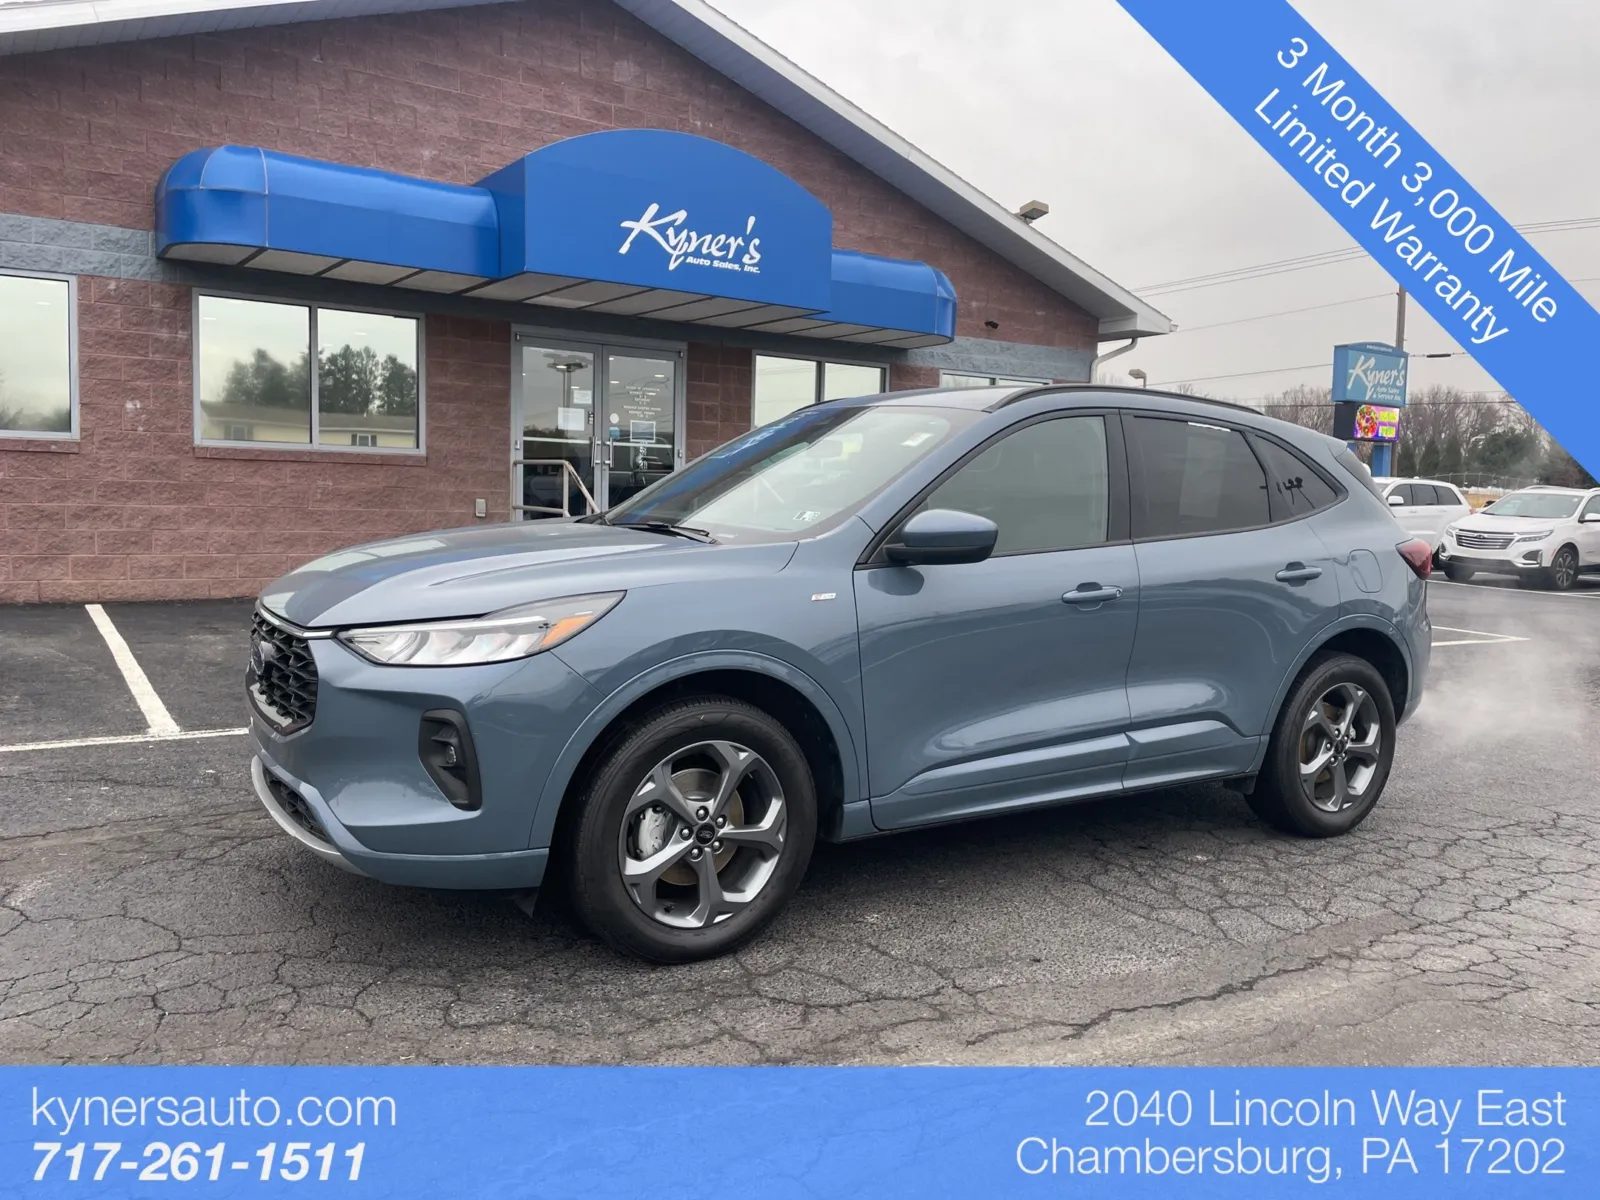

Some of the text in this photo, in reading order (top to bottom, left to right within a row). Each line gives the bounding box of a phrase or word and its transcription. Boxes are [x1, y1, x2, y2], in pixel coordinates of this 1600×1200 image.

[618, 202, 761, 271] Kyner's
[685, 256, 761, 273] Auto Sales, Inc.
[1347, 354, 1405, 400] Kyner's
